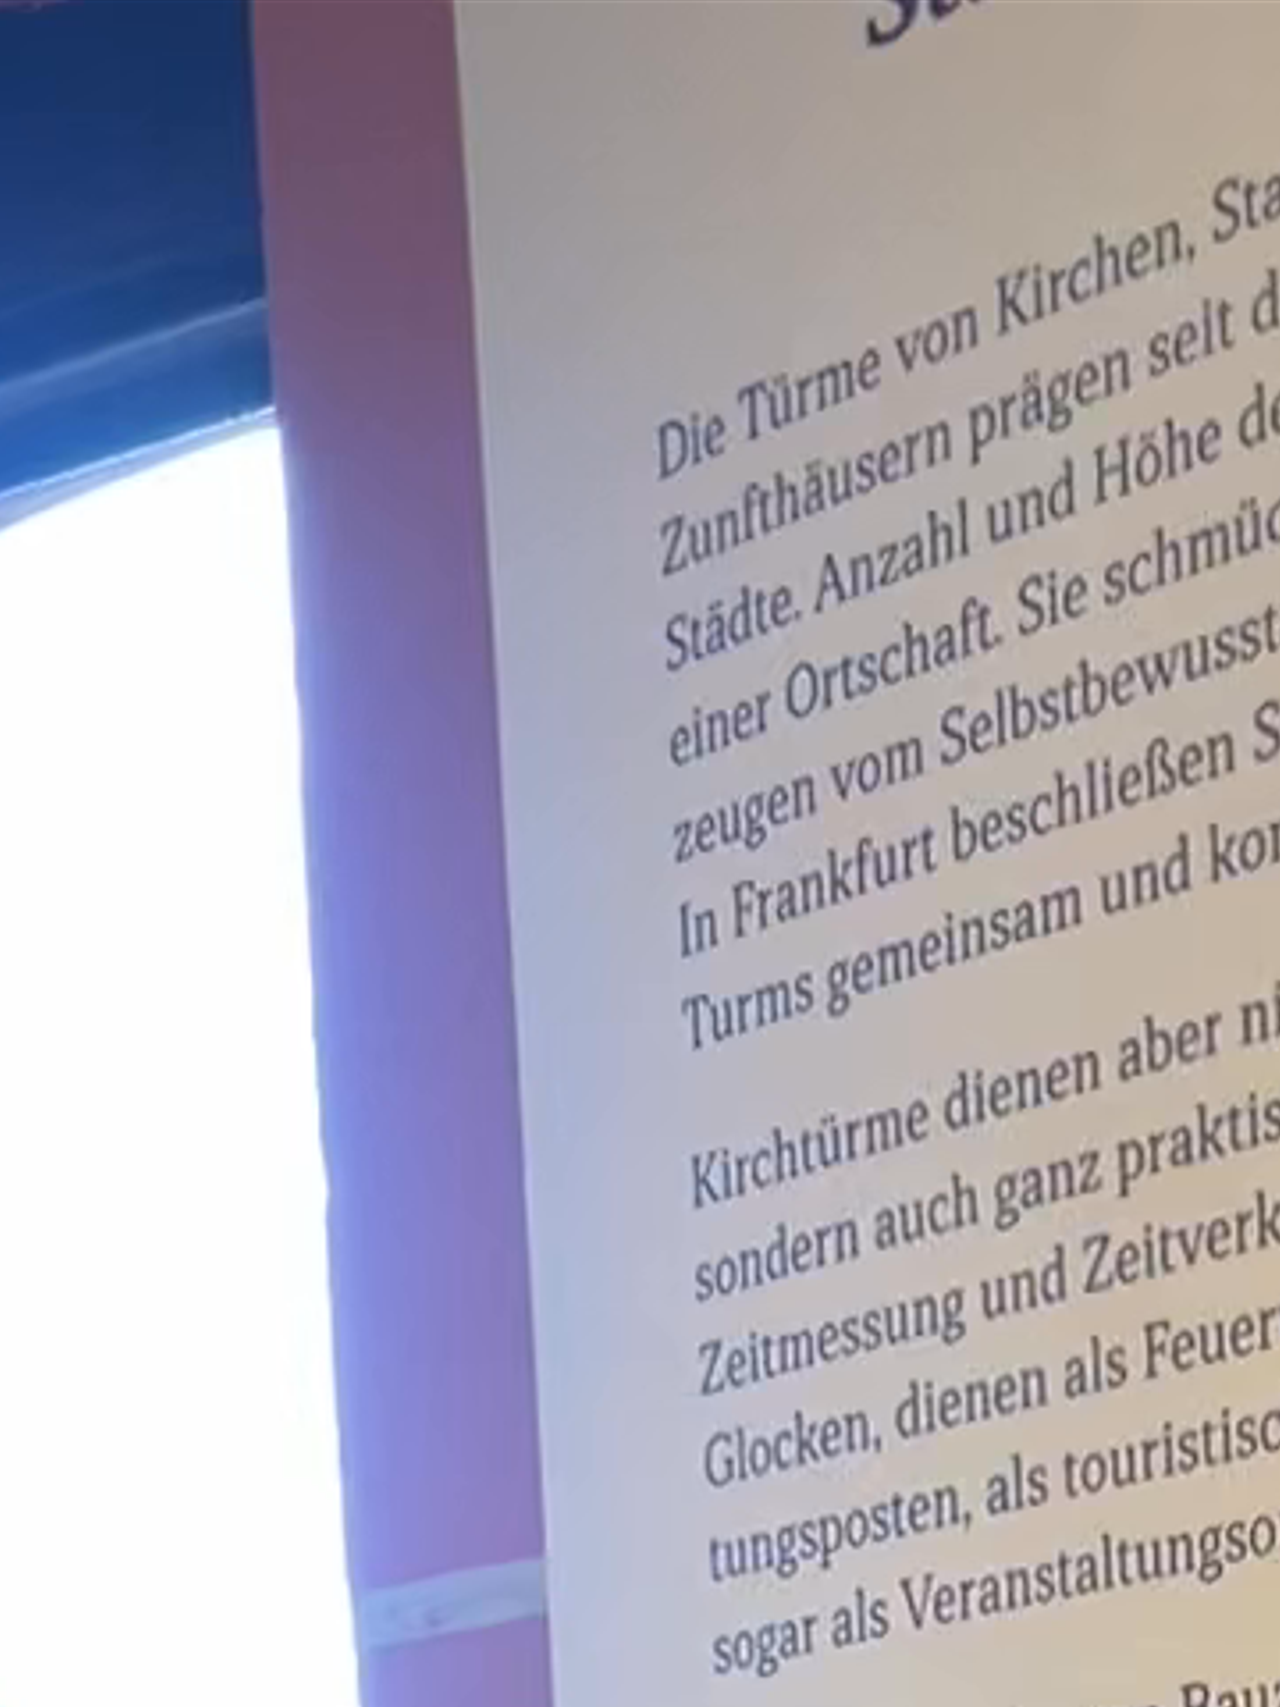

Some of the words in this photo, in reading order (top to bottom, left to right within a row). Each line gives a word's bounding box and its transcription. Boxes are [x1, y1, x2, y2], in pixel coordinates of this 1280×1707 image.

[659, 414, 725, 479] Die
[738, 348, 880, 440] Türme
[895, 307, 978, 372] von
[997, 221, 1195, 335] Kirchen,
[666, 586, 801, 671] Städte.
[814, 497, 969, 613] Anzahl
[987, 457, 1075, 543] und
[1094, 418, 1221, 505] Höhe
[670, 691, 771, 766] einer
[785, 596, 1003, 719] Ortschaft.
[1018, 570, 1087, 636] Sie
[674, 775, 817, 863] zeugen
[830, 737, 924, 800] vom
[692, 1100, 929, 1208] Kirchtürme
[944, 1051, 1100, 1131] dienen
[1118, 1012, 1222, 1082] aber
[699, 1288, 966, 1395] Zeitmessung
[980, 1243, 1067, 1321] und
[705, 1410, 881, 1487] Glocken,
[895, 1367, 1048, 1439] dienen
[1065, 1335, 1128, 1399] als
[710, 1485, 972, 1582] tungsposten,
[986, 1452, 1049, 1516] als
[714, 1615, 818, 1678] sogar
[832, 1587, 889, 1648] als
